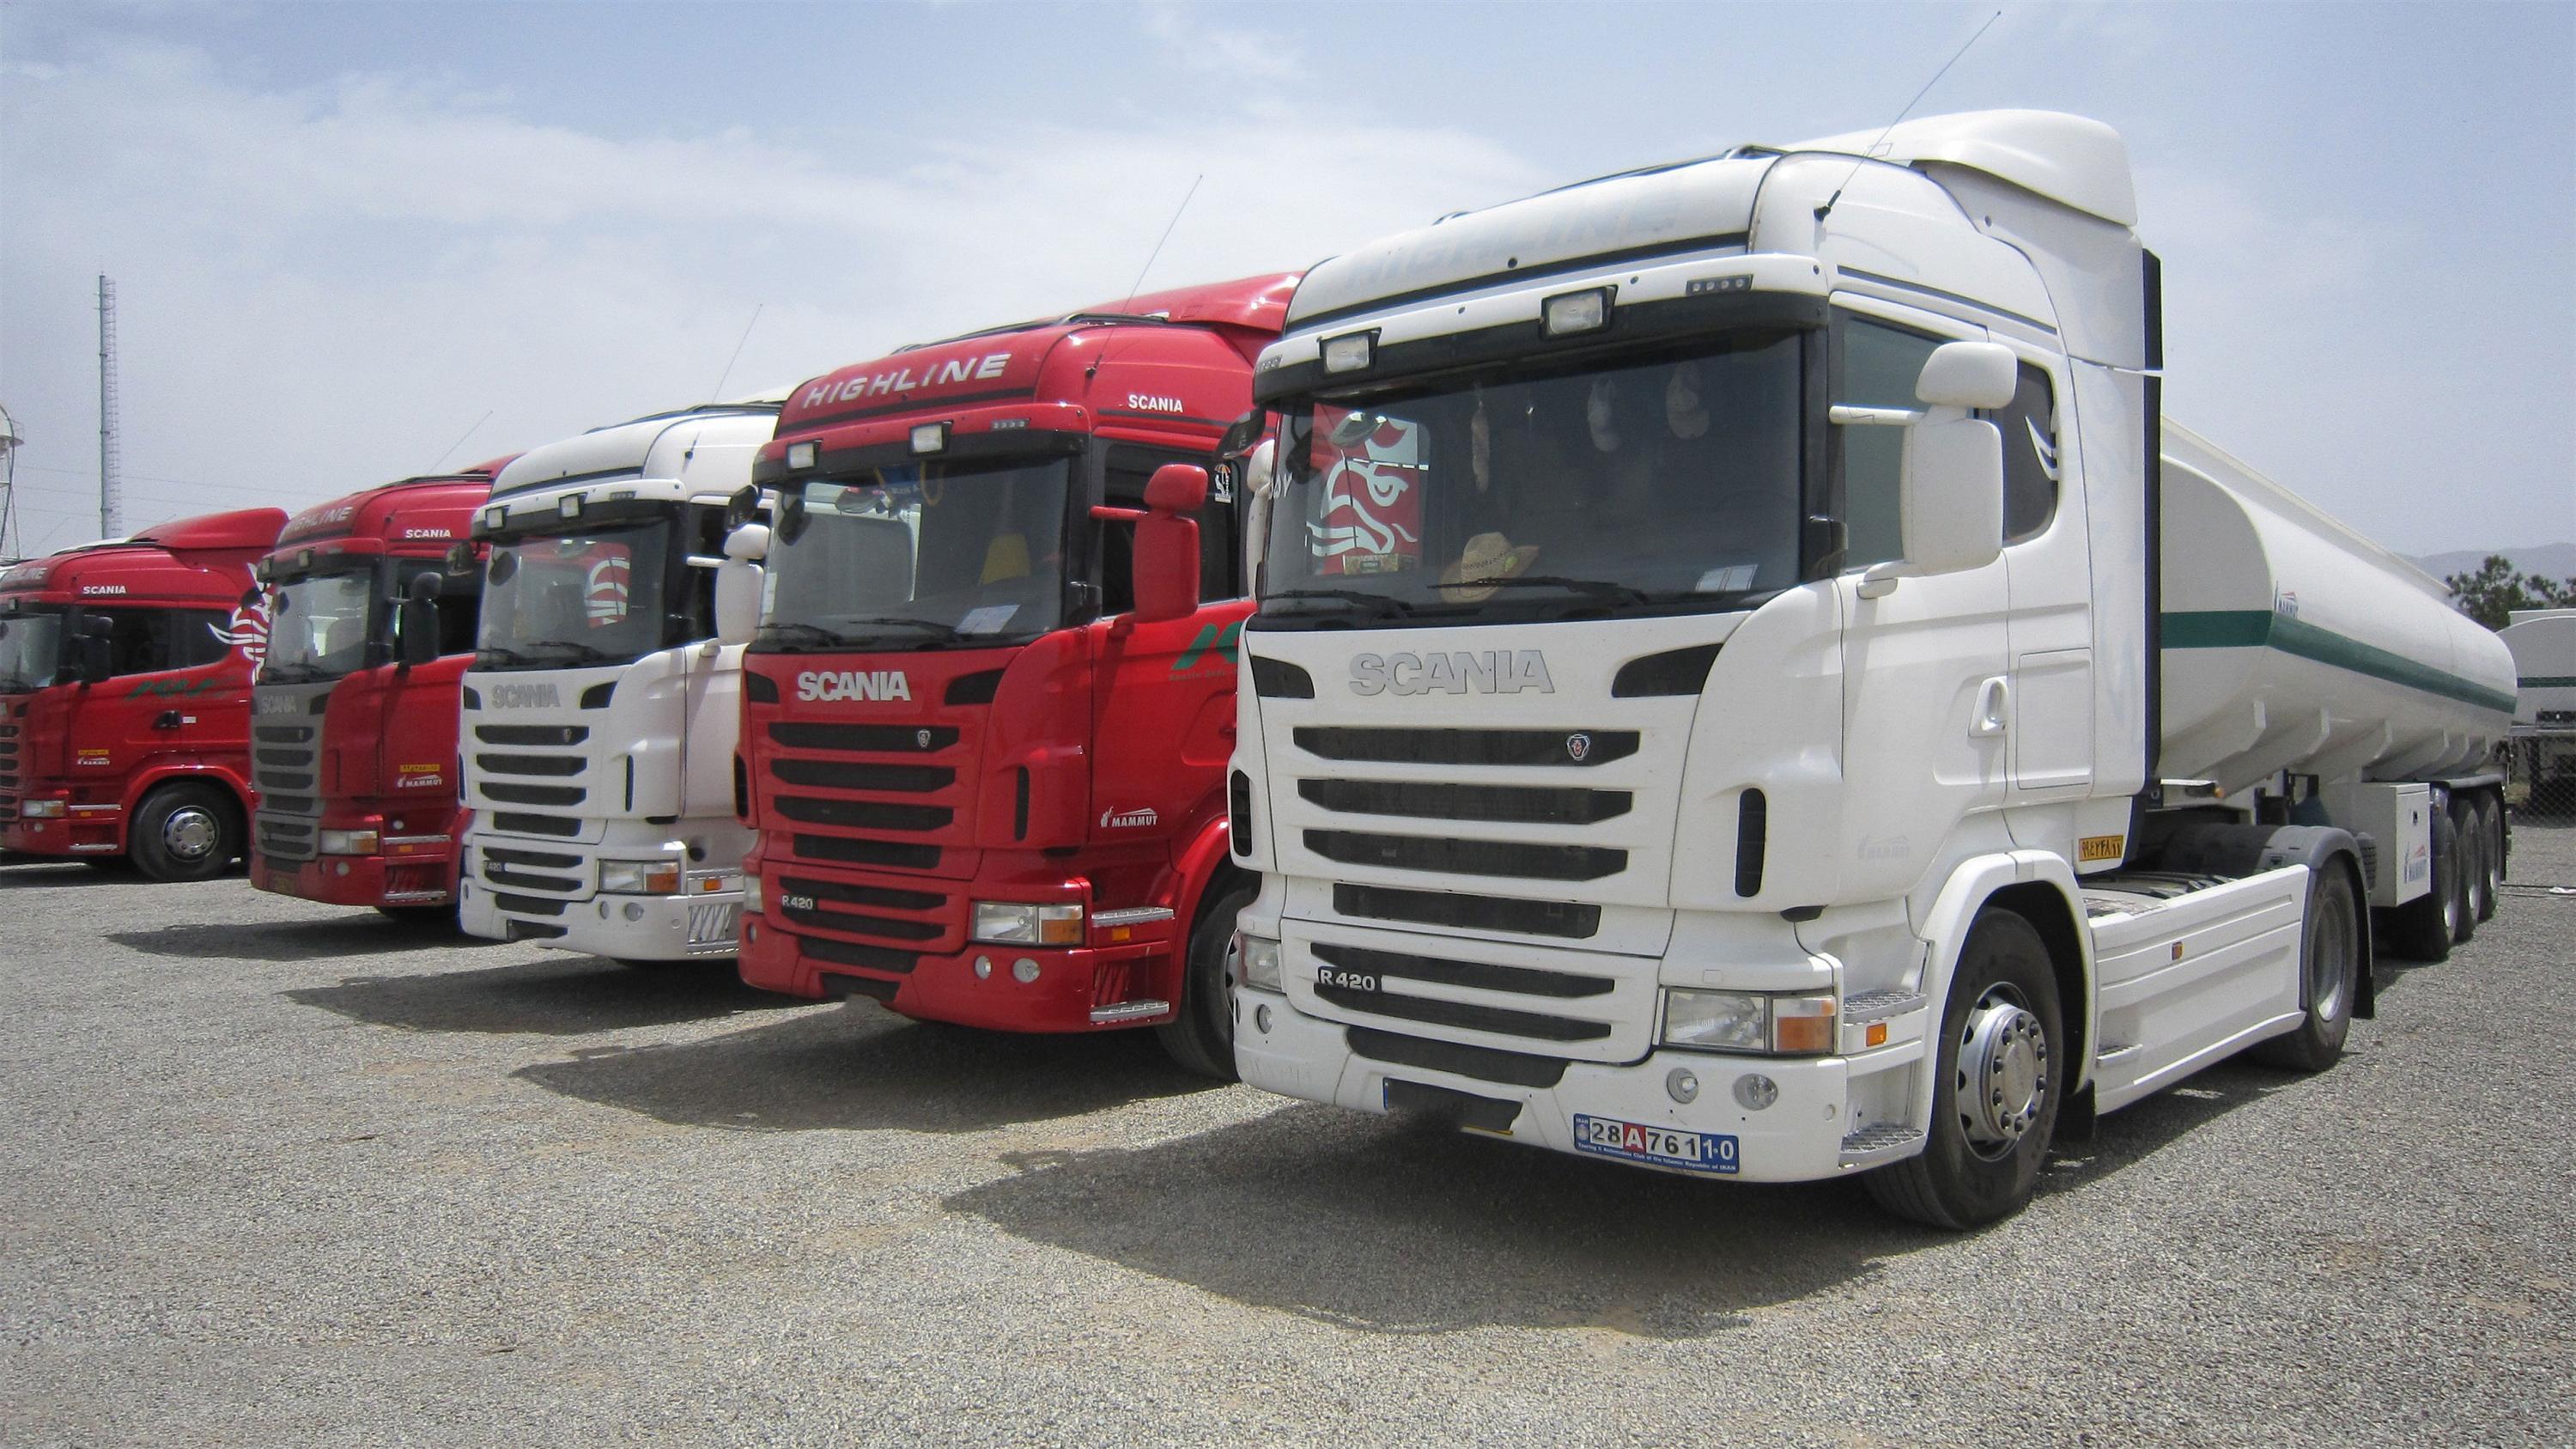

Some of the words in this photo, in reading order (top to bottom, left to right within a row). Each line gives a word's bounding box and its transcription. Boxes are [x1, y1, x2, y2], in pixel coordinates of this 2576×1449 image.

[802, 353, 1012, 409] HIGHLINE
[1128, 394, 1184, 412] SCANIA
[405, 529, 452, 539] SCANIA
[82, 585, 126, 594] SCANIA
[1349, 650, 1555, 697] SCANIA
[798, 671, 912, 701] SCANIA
[492, 684, 562, 709] SCANIA
[1112, 815, 1158, 827] MAMMUT
[1685, 1160, 1710, 1170] Republic
